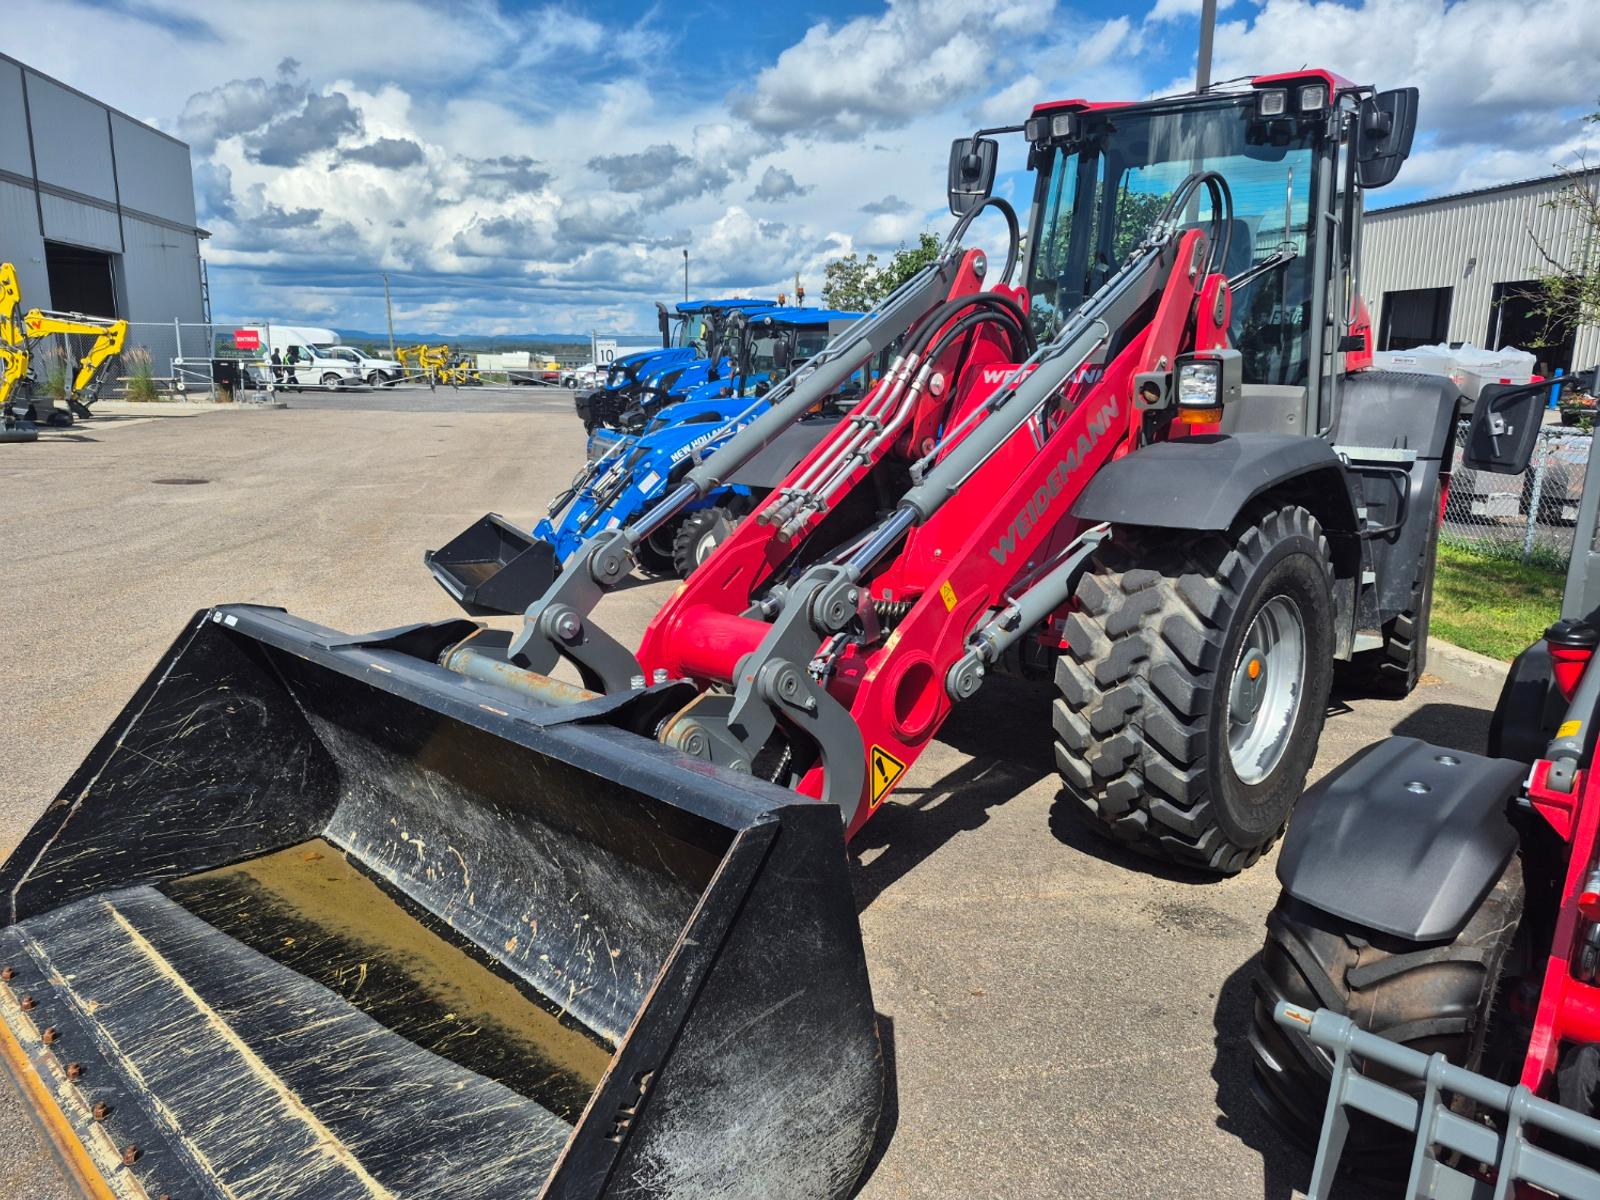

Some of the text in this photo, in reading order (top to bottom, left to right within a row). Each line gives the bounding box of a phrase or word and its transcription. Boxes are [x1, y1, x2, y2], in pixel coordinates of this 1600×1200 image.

[600, 349, 614, 363] 10
[670, 444, 691, 463] NEW
[988, 394, 1119, 566] WEIDEMANN
